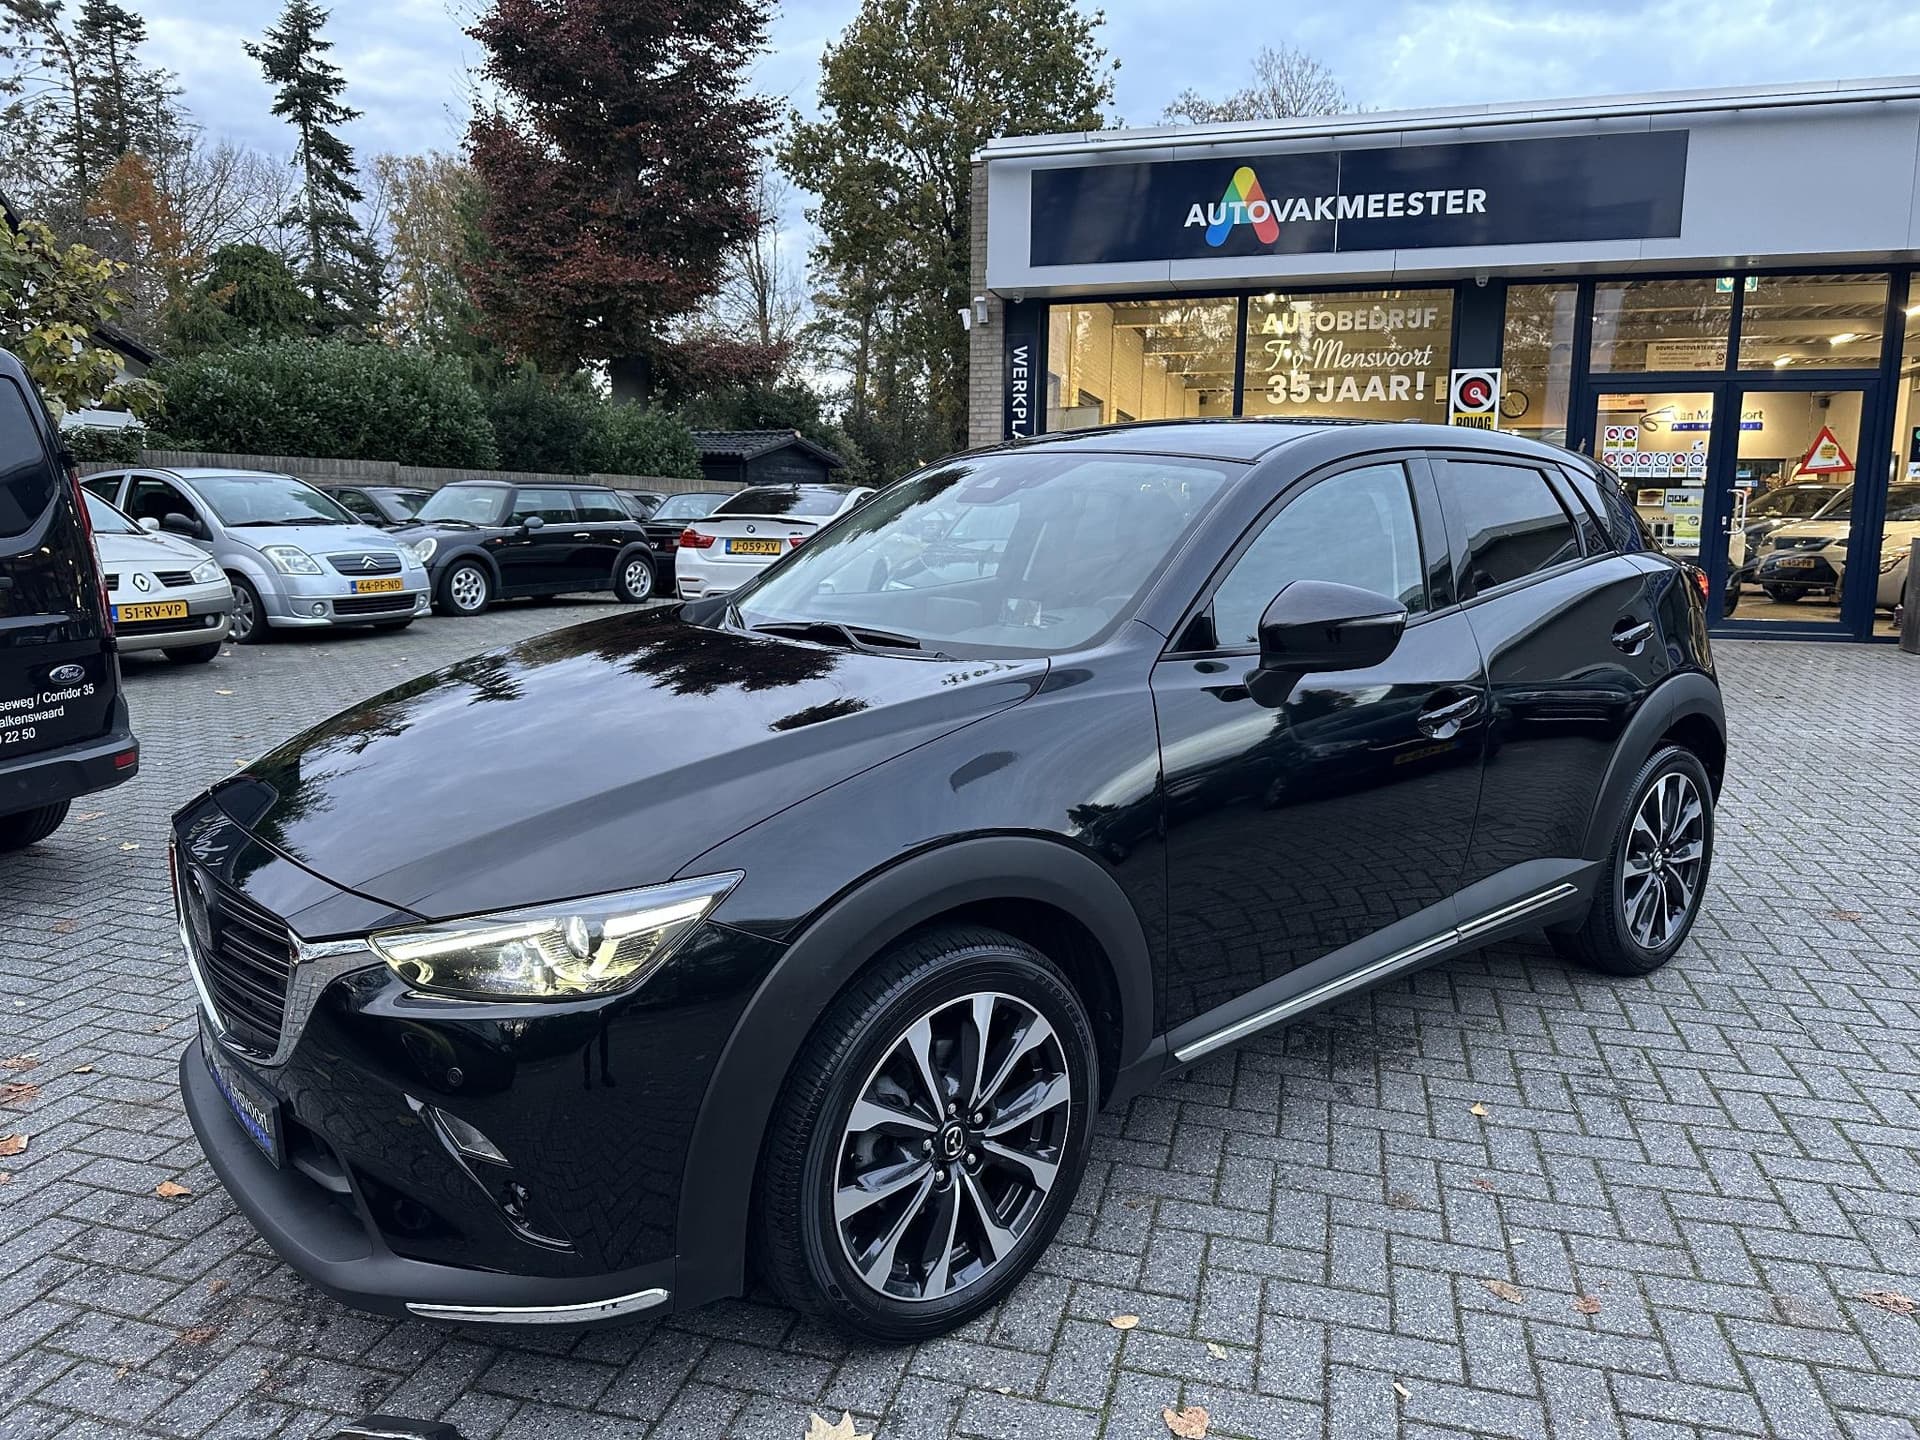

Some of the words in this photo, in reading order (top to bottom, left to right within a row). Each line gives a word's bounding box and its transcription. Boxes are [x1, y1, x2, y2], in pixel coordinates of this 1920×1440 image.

[1183, 188, 1488, 228] AUTOVAKMEESTER
[1261, 307, 1439, 335] AUTOBEDRIJF
[1312, 337, 1433, 370] Mensvoort
[1266, 372, 1311, 405] 35
[1316, 371, 1425, 403] JAAR!
[1455, 416, 1492, 430] BOVAG
[733, 542, 777, 551] J-059-XV
[358, 580, 402, 592] 44-PF-ND
[124, 604, 182, 619] 51-RV-VP
[42, 687, 82, 704] Corridor
[83, 683, 95, 696] 35
[5, 730, 20, 744] 22
[22, 727, 36, 740] 50
